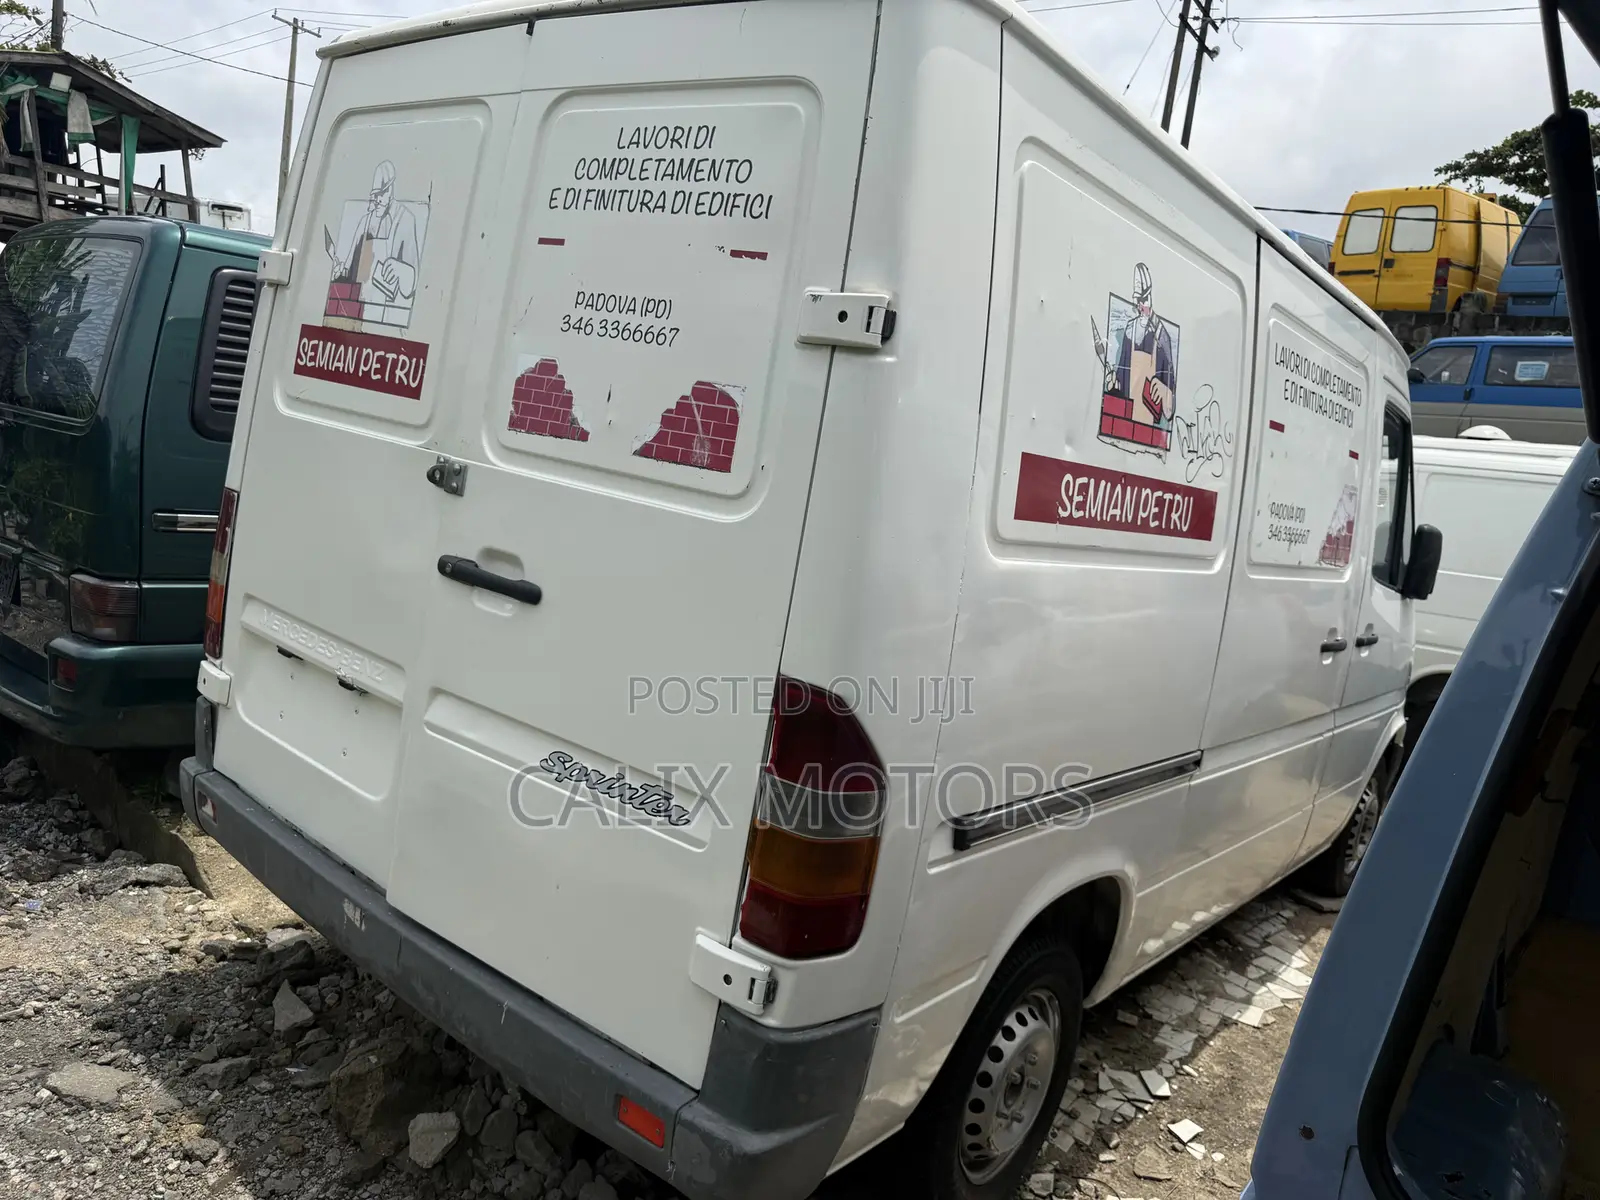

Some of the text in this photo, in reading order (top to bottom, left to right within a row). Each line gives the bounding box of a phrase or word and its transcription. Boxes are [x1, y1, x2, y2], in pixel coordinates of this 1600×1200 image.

[617, 125, 716, 150] LAVORI DI
[574, 157, 753, 184] COMPLETAMENTO
[548, 187, 773, 220] E DI FINITURA DI EDIFICI
[575, 291, 673, 320] PADOVA (PD)
[560, 314, 680, 347] 346 3366667
[297, 337, 359, 374] SEMIAN
[1058, 473, 1194, 532] SEMIAN PETRU
[260, 608, 387, 682] MERCEDES-BENZ
[540, 750, 691, 827] Sprinter
